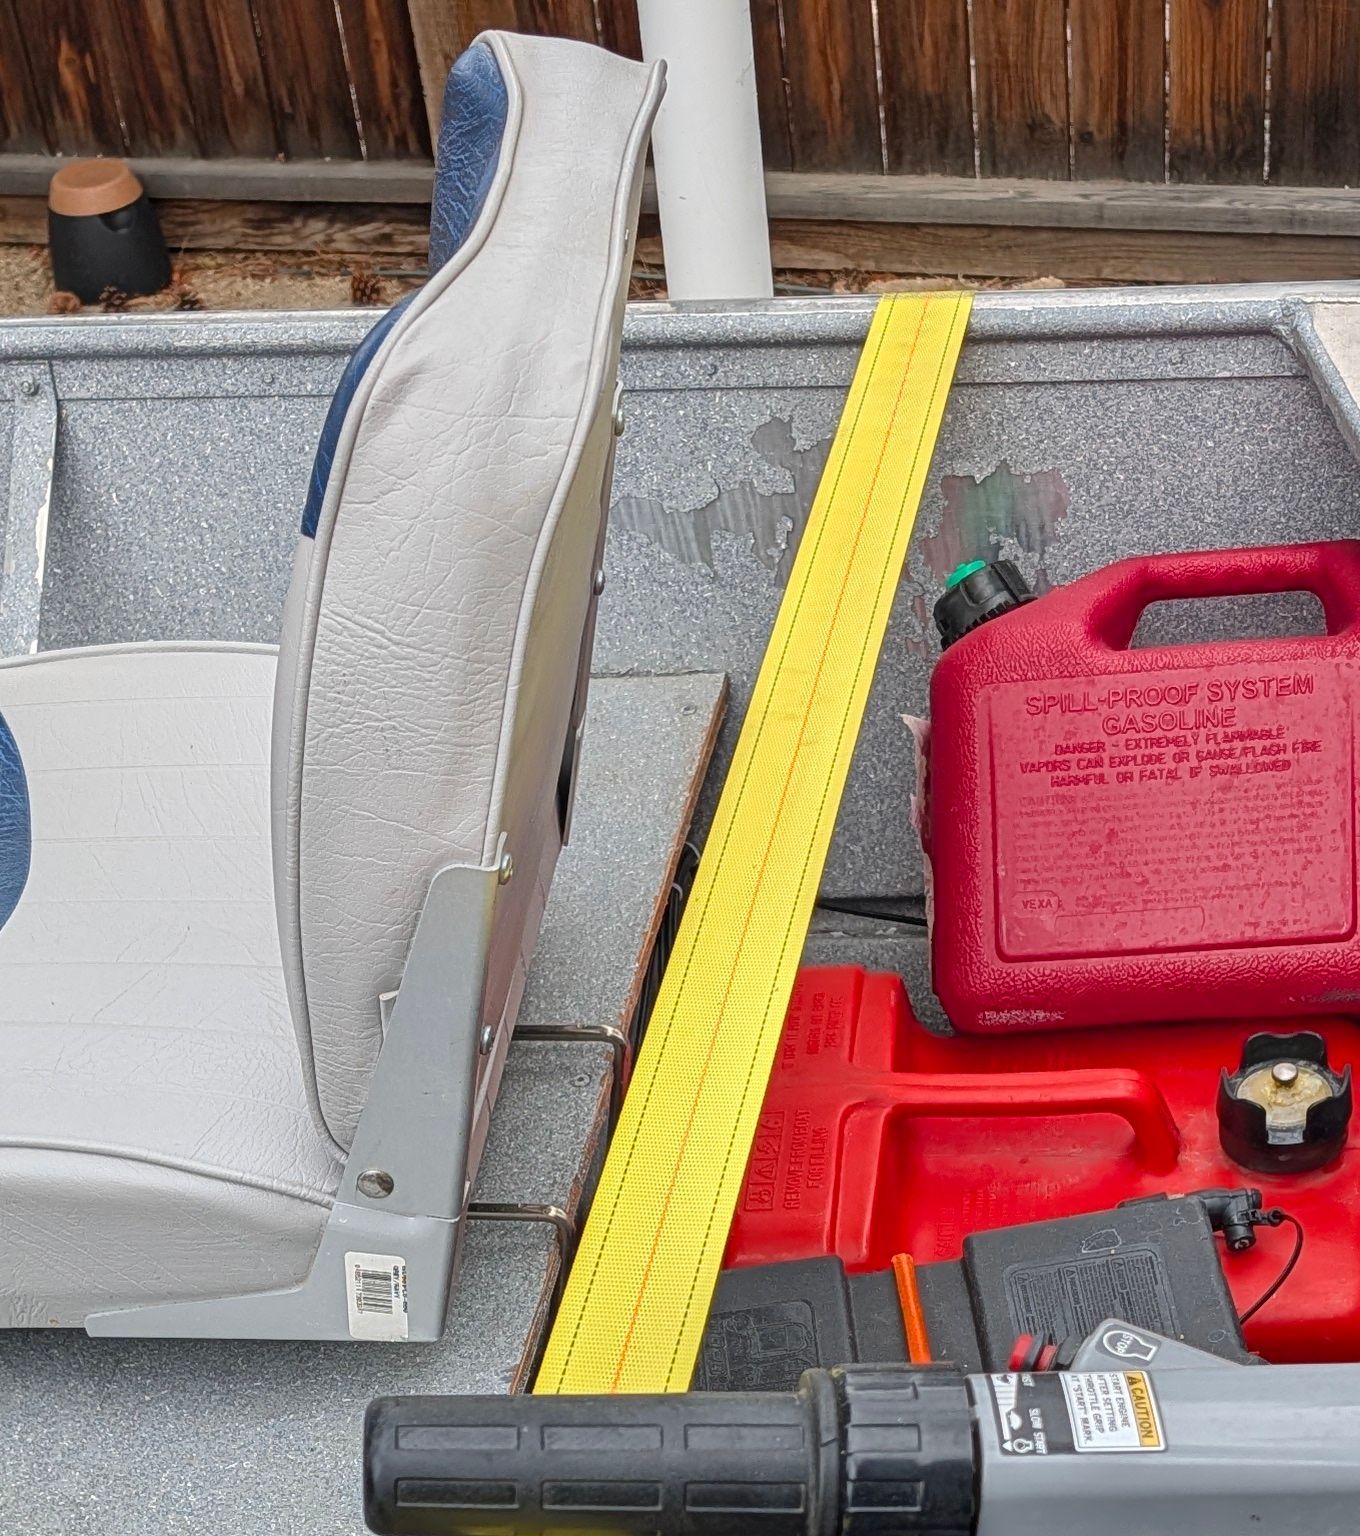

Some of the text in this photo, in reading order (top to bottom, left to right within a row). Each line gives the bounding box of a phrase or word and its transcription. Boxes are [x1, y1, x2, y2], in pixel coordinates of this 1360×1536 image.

[1025, 674, 1314, 716] SPILL-PROOF SYSTEM
[1101, 705, 1237, 736] GASOLINE
[1054, 741, 1106, 756] DANGER
[1124, 733, 1200, 751] EXTREMELY
[1205, 724, 1287, 745] FLAMMABLE
[1020, 759, 1071, 775] VAPORS
[1076, 755, 1104, 770] CAN
[1109, 750, 1167, 767] EXPLODE
[1172, 749, 1191, 764] OR
[1239, 741, 1287, 757] FLASH
[1291, 739, 1323, 754] FIRE
[1050, 758, 1292, 788] HARMFUL OR FATAL IF SWALLOWED
[1116, 1332, 1134, 1354] STOP
[1083, 1374, 1105, 1434] THROTTLE GRIP
[1108, 1372, 1131, 1429] START ENGINE
[1131, 1389, 1155, 1440] CAUTION
[1029, 1408, 1043, 1429] SLOW
[1102, 1401, 1118, 1433] SETTING
[1033, 1431, 1048, 1455] START
